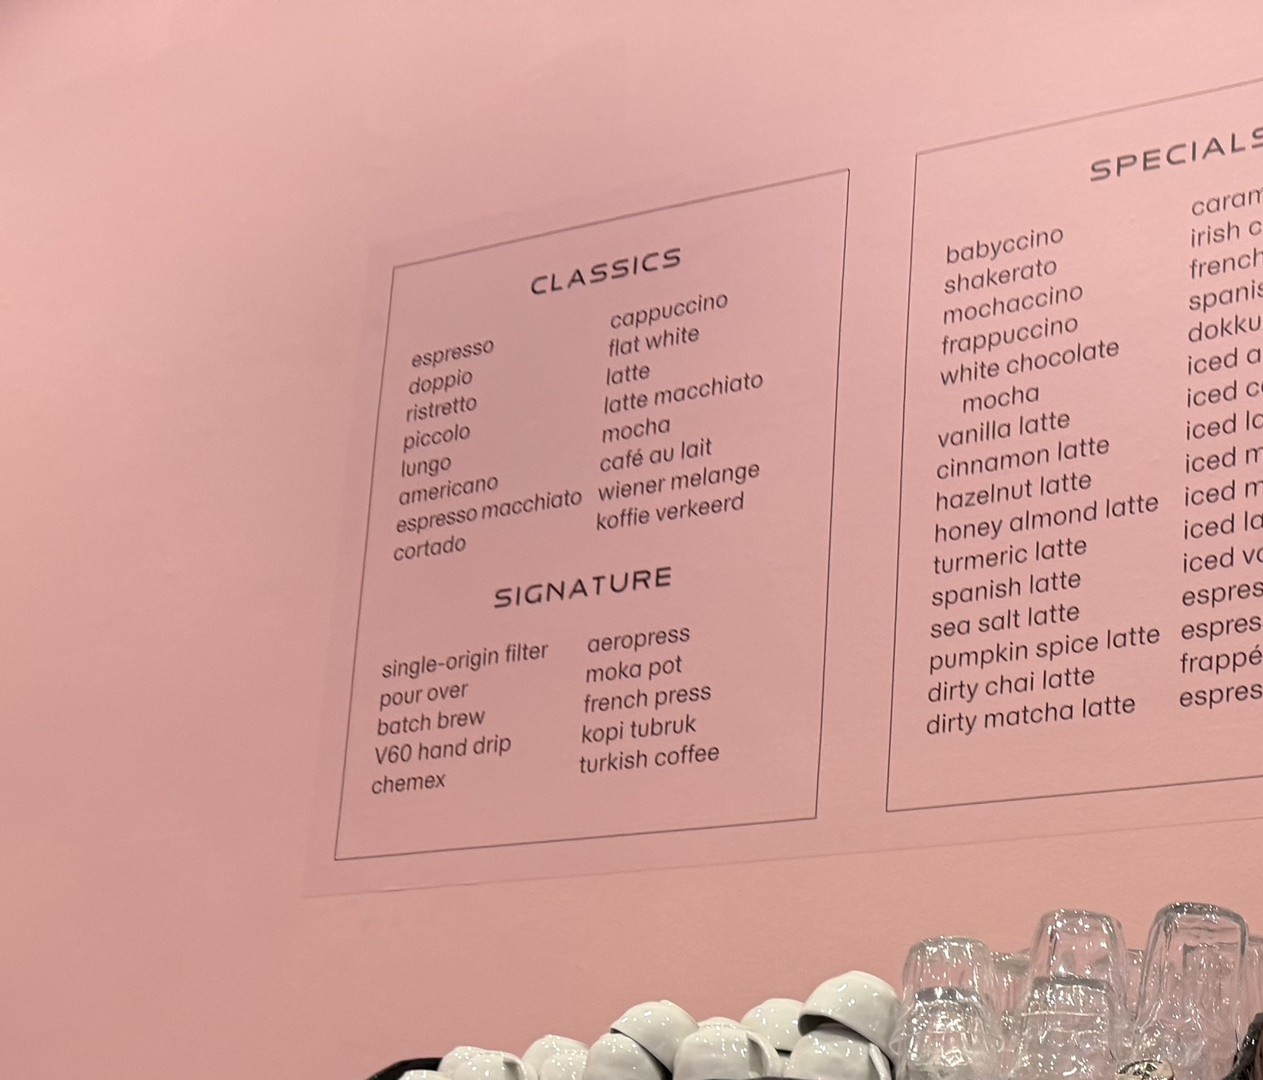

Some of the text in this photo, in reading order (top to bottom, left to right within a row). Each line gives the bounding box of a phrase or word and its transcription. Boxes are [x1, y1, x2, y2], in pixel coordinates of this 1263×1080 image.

[946, 228, 1064, 265] babyccino
[1191, 220, 1240, 249] irish
[530, 247, 681, 296] CLASSICS
[943, 258, 1058, 295] shakerato
[610, 293, 729, 330] cappuccino
[943, 285, 1084, 326] mochaccino
[608, 325, 700, 358] flat white
[941, 316, 1079, 356] frappuccino
[411, 339, 495, 369] espresso
[939, 339, 1120, 387] white chocolate
[1187, 346, 1238, 376] iced
[408, 368, 474, 396] doppio
[606, 363, 651, 387] latte
[405, 395, 478, 423] ristretto
[603, 371, 764, 415] latte macchiato
[962, 384, 1040, 414] mocha
[1186, 378, 1238, 409] iced
[402, 422, 471, 455] piccolo
[601, 416, 671, 444] mocha
[937, 411, 1071, 449] vanilla latte
[1186, 411, 1237, 441] iced
[400, 456, 452, 479] lungo
[599, 437, 713, 473] café au lait
[936, 436, 1110, 480] cinnamon latte
[1185, 445, 1237, 475] iced
[398, 476, 499, 506] americano
[597, 463, 760, 502] wiener melange
[935, 471, 1092, 512] hazelnut latte
[1184, 478, 1236, 508] iced
[395, 488, 583, 535] espresso macchiato
[596, 489, 745, 532] koffie verkeerd
[934, 493, 1160, 544] honey almond latte
[1183, 511, 1235, 541] iced
[393, 534, 467, 562] cortado
[932, 536, 1088, 575] turmeric latte
[1183, 545, 1235, 574] iced
[493, 565, 672, 610] SIGNATURE
[931, 570, 1082, 611] spanish latte
[930, 602, 1081, 639] sea salt latte
[587, 626, 691, 654] aeropress
[929, 625, 1161, 676] pumpkin spice latte
[381, 642, 550, 680] single-origin filter
[585, 654, 683, 684] moka pot
[1179, 643, 1263, 676] frappé
[379, 682, 470, 713] pour over
[583, 685, 712, 714] french press
[927, 666, 1096, 704] dirty chai latte
[376, 710, 486, 737] batch brew
[581, 713, 697, 747] kopi tubruk
[926, 694, 1136, 737] dirty matcha latte
[374, 733, 512, 766] V60 hand drip
[579, 743, 720, 775] turkish coffee
[370, 773, 447, 795] chemex
